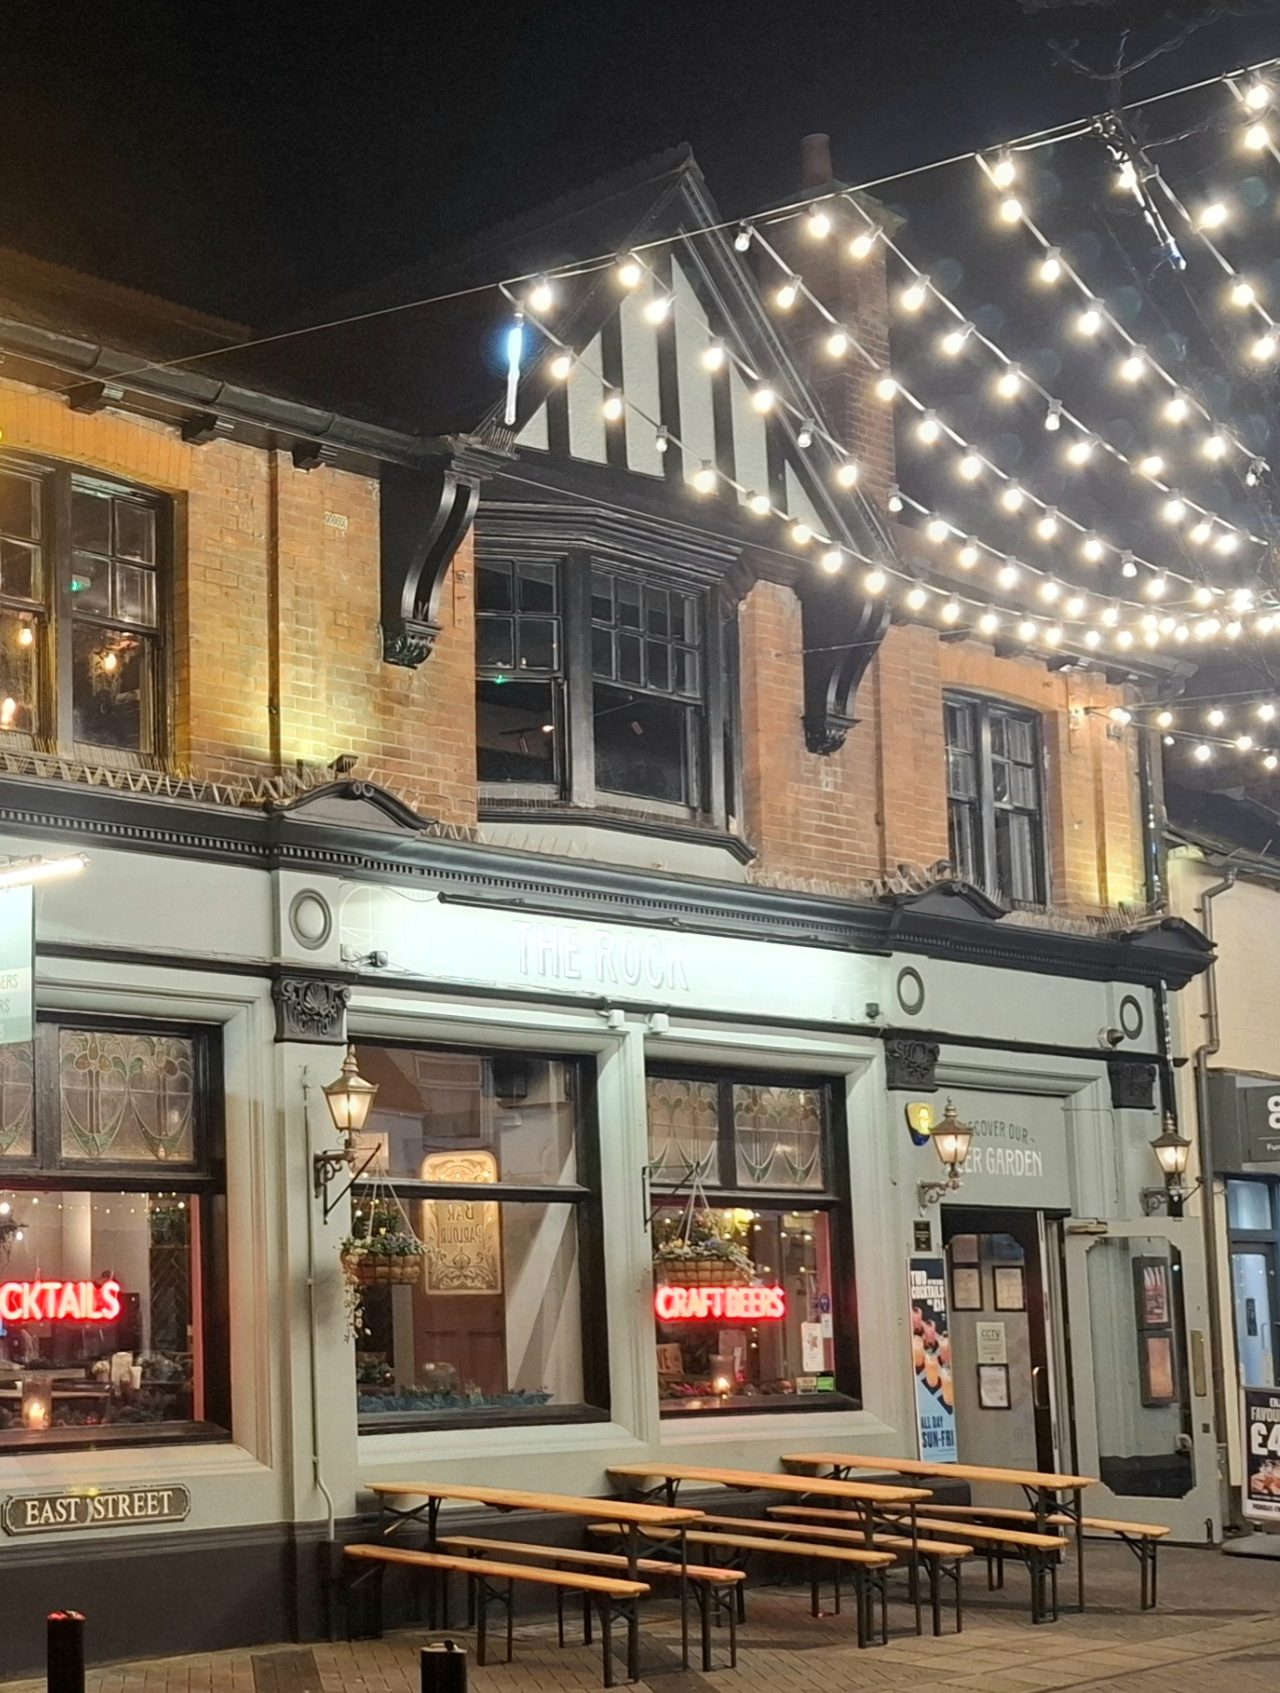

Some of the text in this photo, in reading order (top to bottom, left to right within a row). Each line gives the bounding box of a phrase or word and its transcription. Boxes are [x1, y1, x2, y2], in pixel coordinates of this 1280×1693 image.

[513, 919, 689, 991] THE ROCK
[1008, 1123, 1029, 1144] OUR
[985, 1147, 1043, 1177] GARDEN
[656, 1286, 724, 1319] CRAFT
[725, 1286, 785, 1318] BEERS
[911, 1285, 945, 1300] COCKTAILS
[921, 1416, 943, 1429] ALL DAY
[921, 1430, 954, 1448] SUN-FRI
[25, 1491, 173, 1526] EAST STREET
